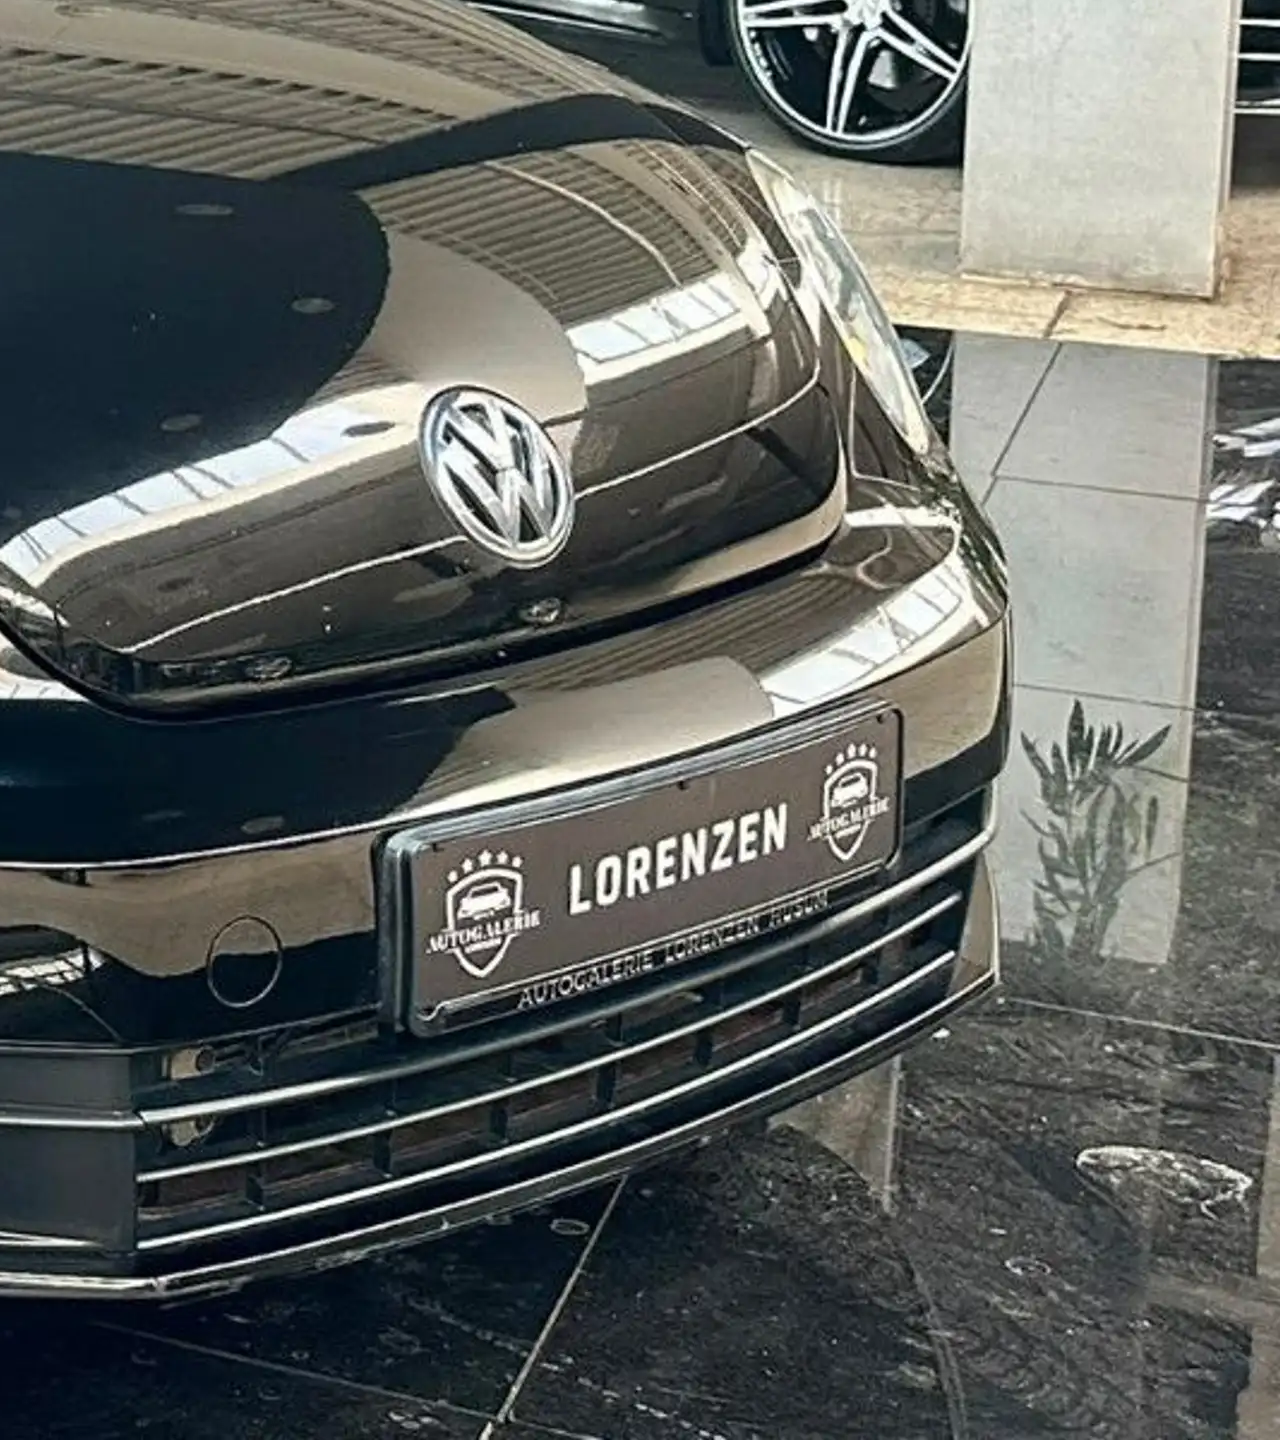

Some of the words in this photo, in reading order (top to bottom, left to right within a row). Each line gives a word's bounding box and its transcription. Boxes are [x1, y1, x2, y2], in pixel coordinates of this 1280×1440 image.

[430, 392, 568, 558] VW
[569, 802, 788, 916] LORENZEN
[425, 910, 541, 954] AUTOGALERIE
[516, 950, 654, 1009] AUTOGALERIE
[664, 914, 761, 962] LORENZEN
